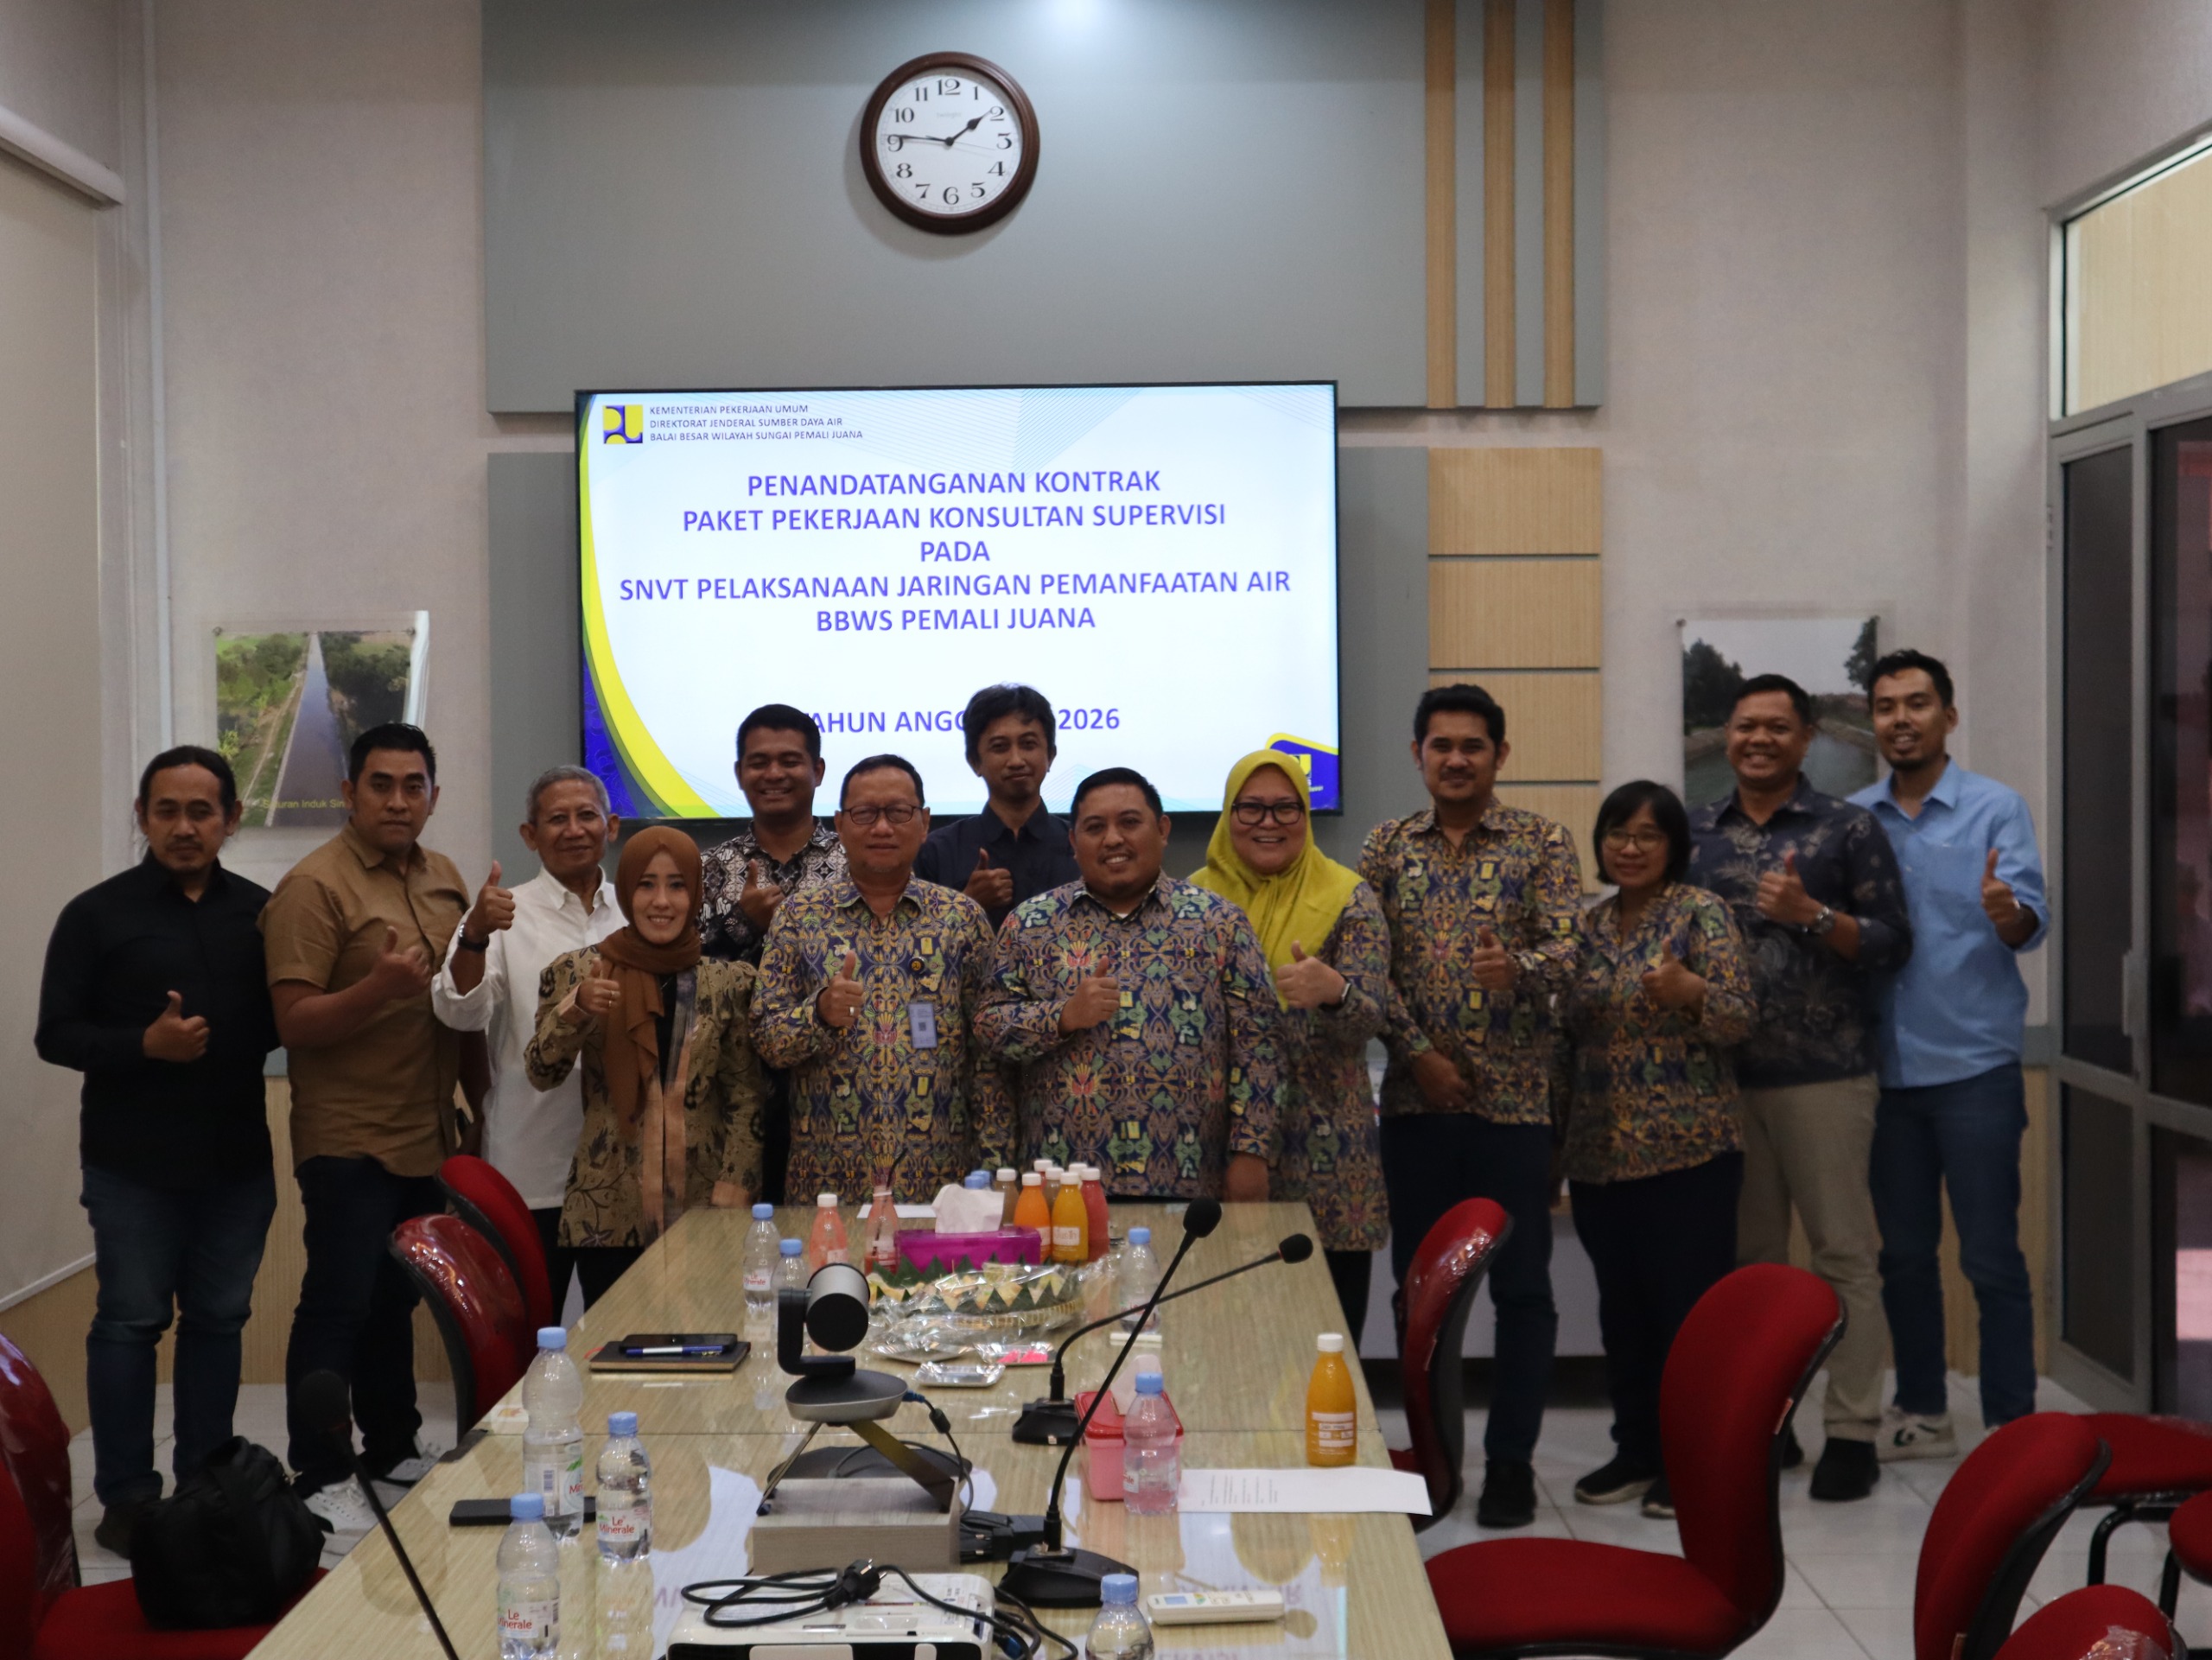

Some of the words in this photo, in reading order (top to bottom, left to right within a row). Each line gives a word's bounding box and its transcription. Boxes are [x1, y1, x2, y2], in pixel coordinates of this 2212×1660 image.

[915, 87, 929, 102] 11
[937, 79, 961, 95] 12
[973, 86, 979, 100] 1
[894, 107, 914, 123] 10
[989, 106, 1004, 121] 2
[887, 134, 904, 152] 9
[996, 133, 1012, 149] 3
[896, 163, 912, 178] 8
[988, 162, 1006, 176] 4
[915, 184, 931, 199] 7
[943, 187, 959, 205] 6
[970, 182, 985, 198] 5
[649, 405, 717, 415] KEMENTERIAN
[719, 404, 772, 414] PEKERJAAN
[774, 404, 809, 414] UMUM
[650, 419, 708, 429] DIREKTORAT
[709, 418, 756, 428] JENDERAL
[758, 417, 798, 427] SUMBER
[800, 417, 825, 427] DAYA
[826, 417, 843, 426] AIR
[650, 432, 677, 442] BALAI
[679, 432, 709, 442] BESAR
[711, 431, 753, 441] WILAYAH
[755, 430, 792, 440] SUNGAI
[794, 430, 830, 440] PEMALI
[831, 429, 863, 439] JUANA
[747, 472, 1026, 497] PENANDATANGANAN
[1035, 470, 1160, 493] KONTRAK
[683, 509, 764, 532] PAKET
[772, 507, 920, 531] PEKERJAAN
[930, 506, 1084, 529] KONSULTAN
[1092, 503, 1225, 527] SUPERVISI
[920, 540, 990, 563] PADA
[620, 578, 689, 601] SNVT
[697, 576, 888, 600] PELAKSANAAN
[896, 574, 1031, 597] JARINGAN
[1040, 571, 1237, 595] PEMANFAATAN
[1246, 570, 1291, 592] AIR
[817, 609, 893, 632] BBWS
[901, 608, 999, 631] PEMALI
[1007, 607, 1096, 630] JUANA
[812, 711, 886, 734] AHUN
[1058, 708, 1120, 730] 2026
[301, 798, 327, 809] Induk
[612, 1516, 624, 1527] Le
[507, 1608, 520, 1621] Le
